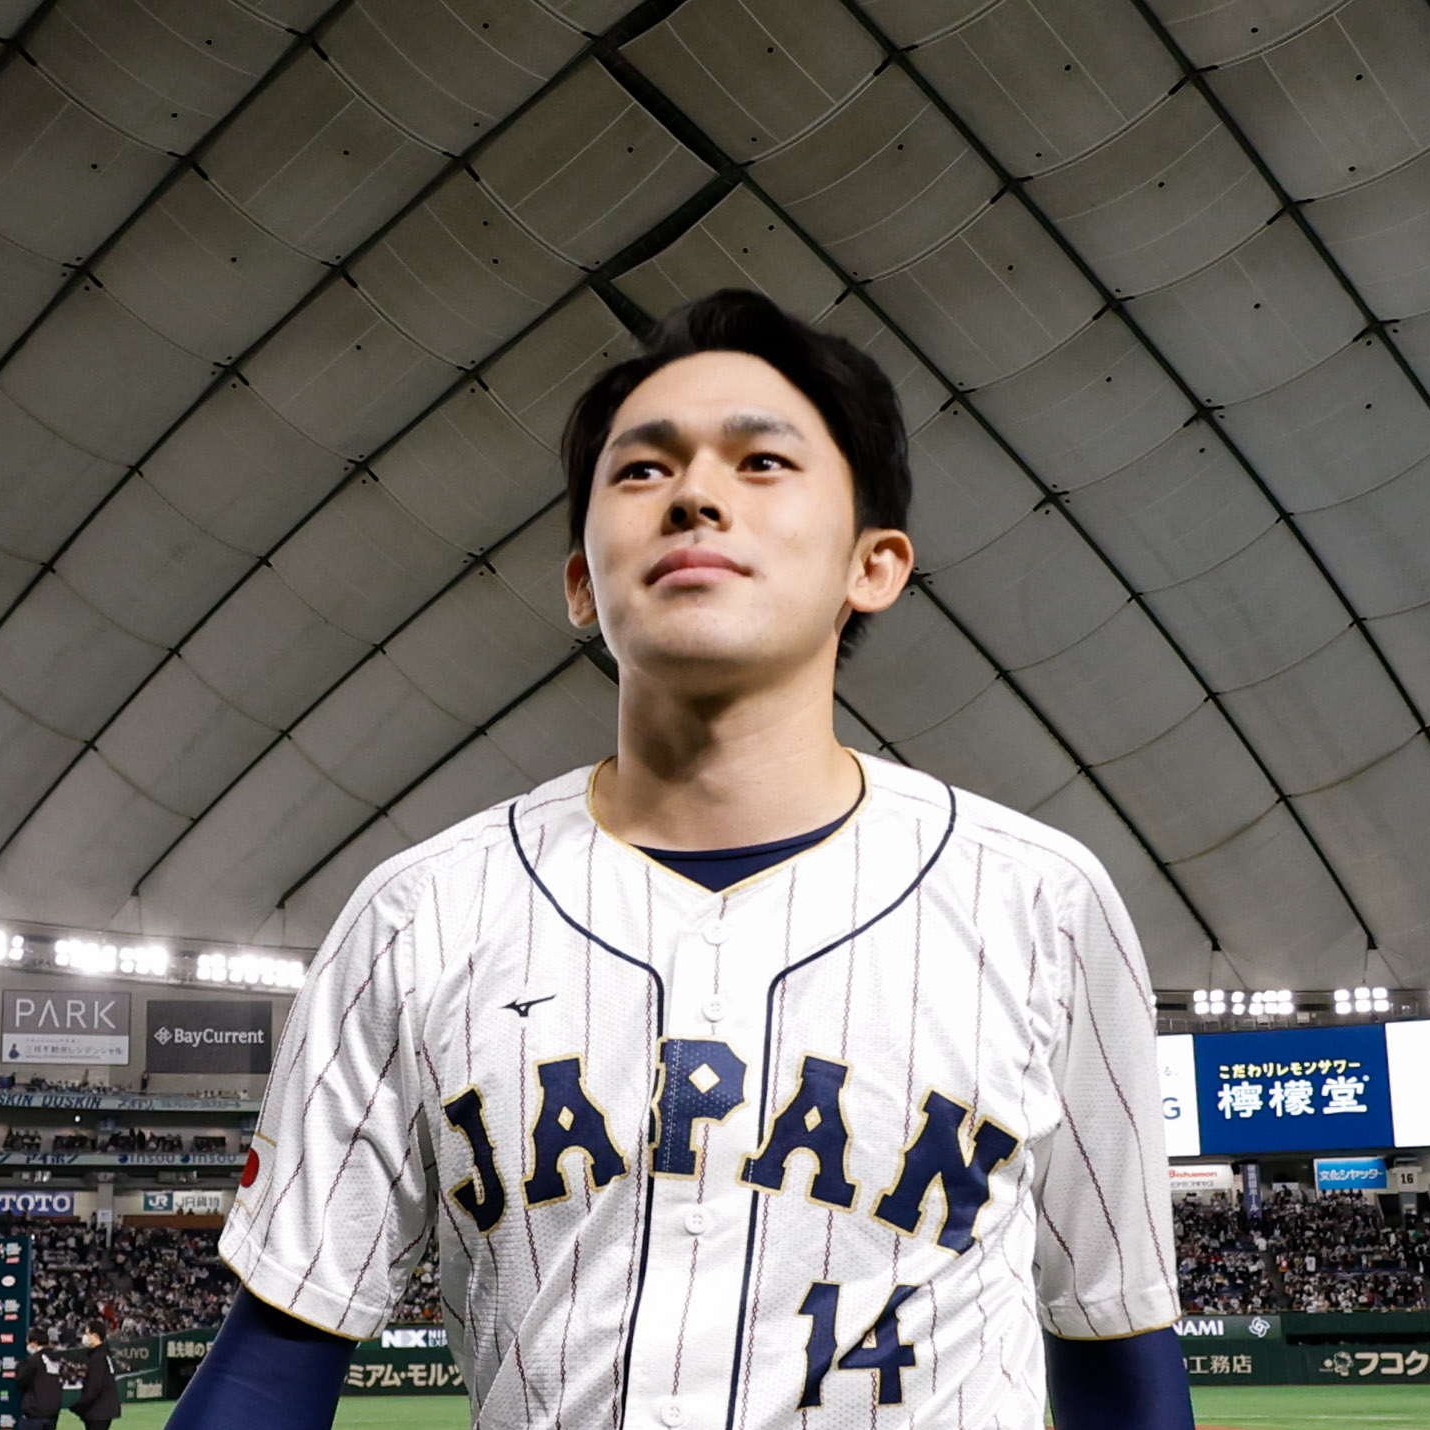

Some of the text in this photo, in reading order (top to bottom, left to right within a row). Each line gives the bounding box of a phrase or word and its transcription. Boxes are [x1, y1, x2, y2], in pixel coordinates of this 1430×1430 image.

[15, 998, 117, 1029] PARK
[173, 1027, 265, 1046] BayCurrent
[1218, 1059, 1361, 1079] こだわりレモンサワー
[1217, 1075, 1368, 1119] 檸檬堂
[442, 1036, 1024, 1258] JAPAN
[1400, 1173, 1414, 1185] 16
[798, 1279, 921, 1411] 14
